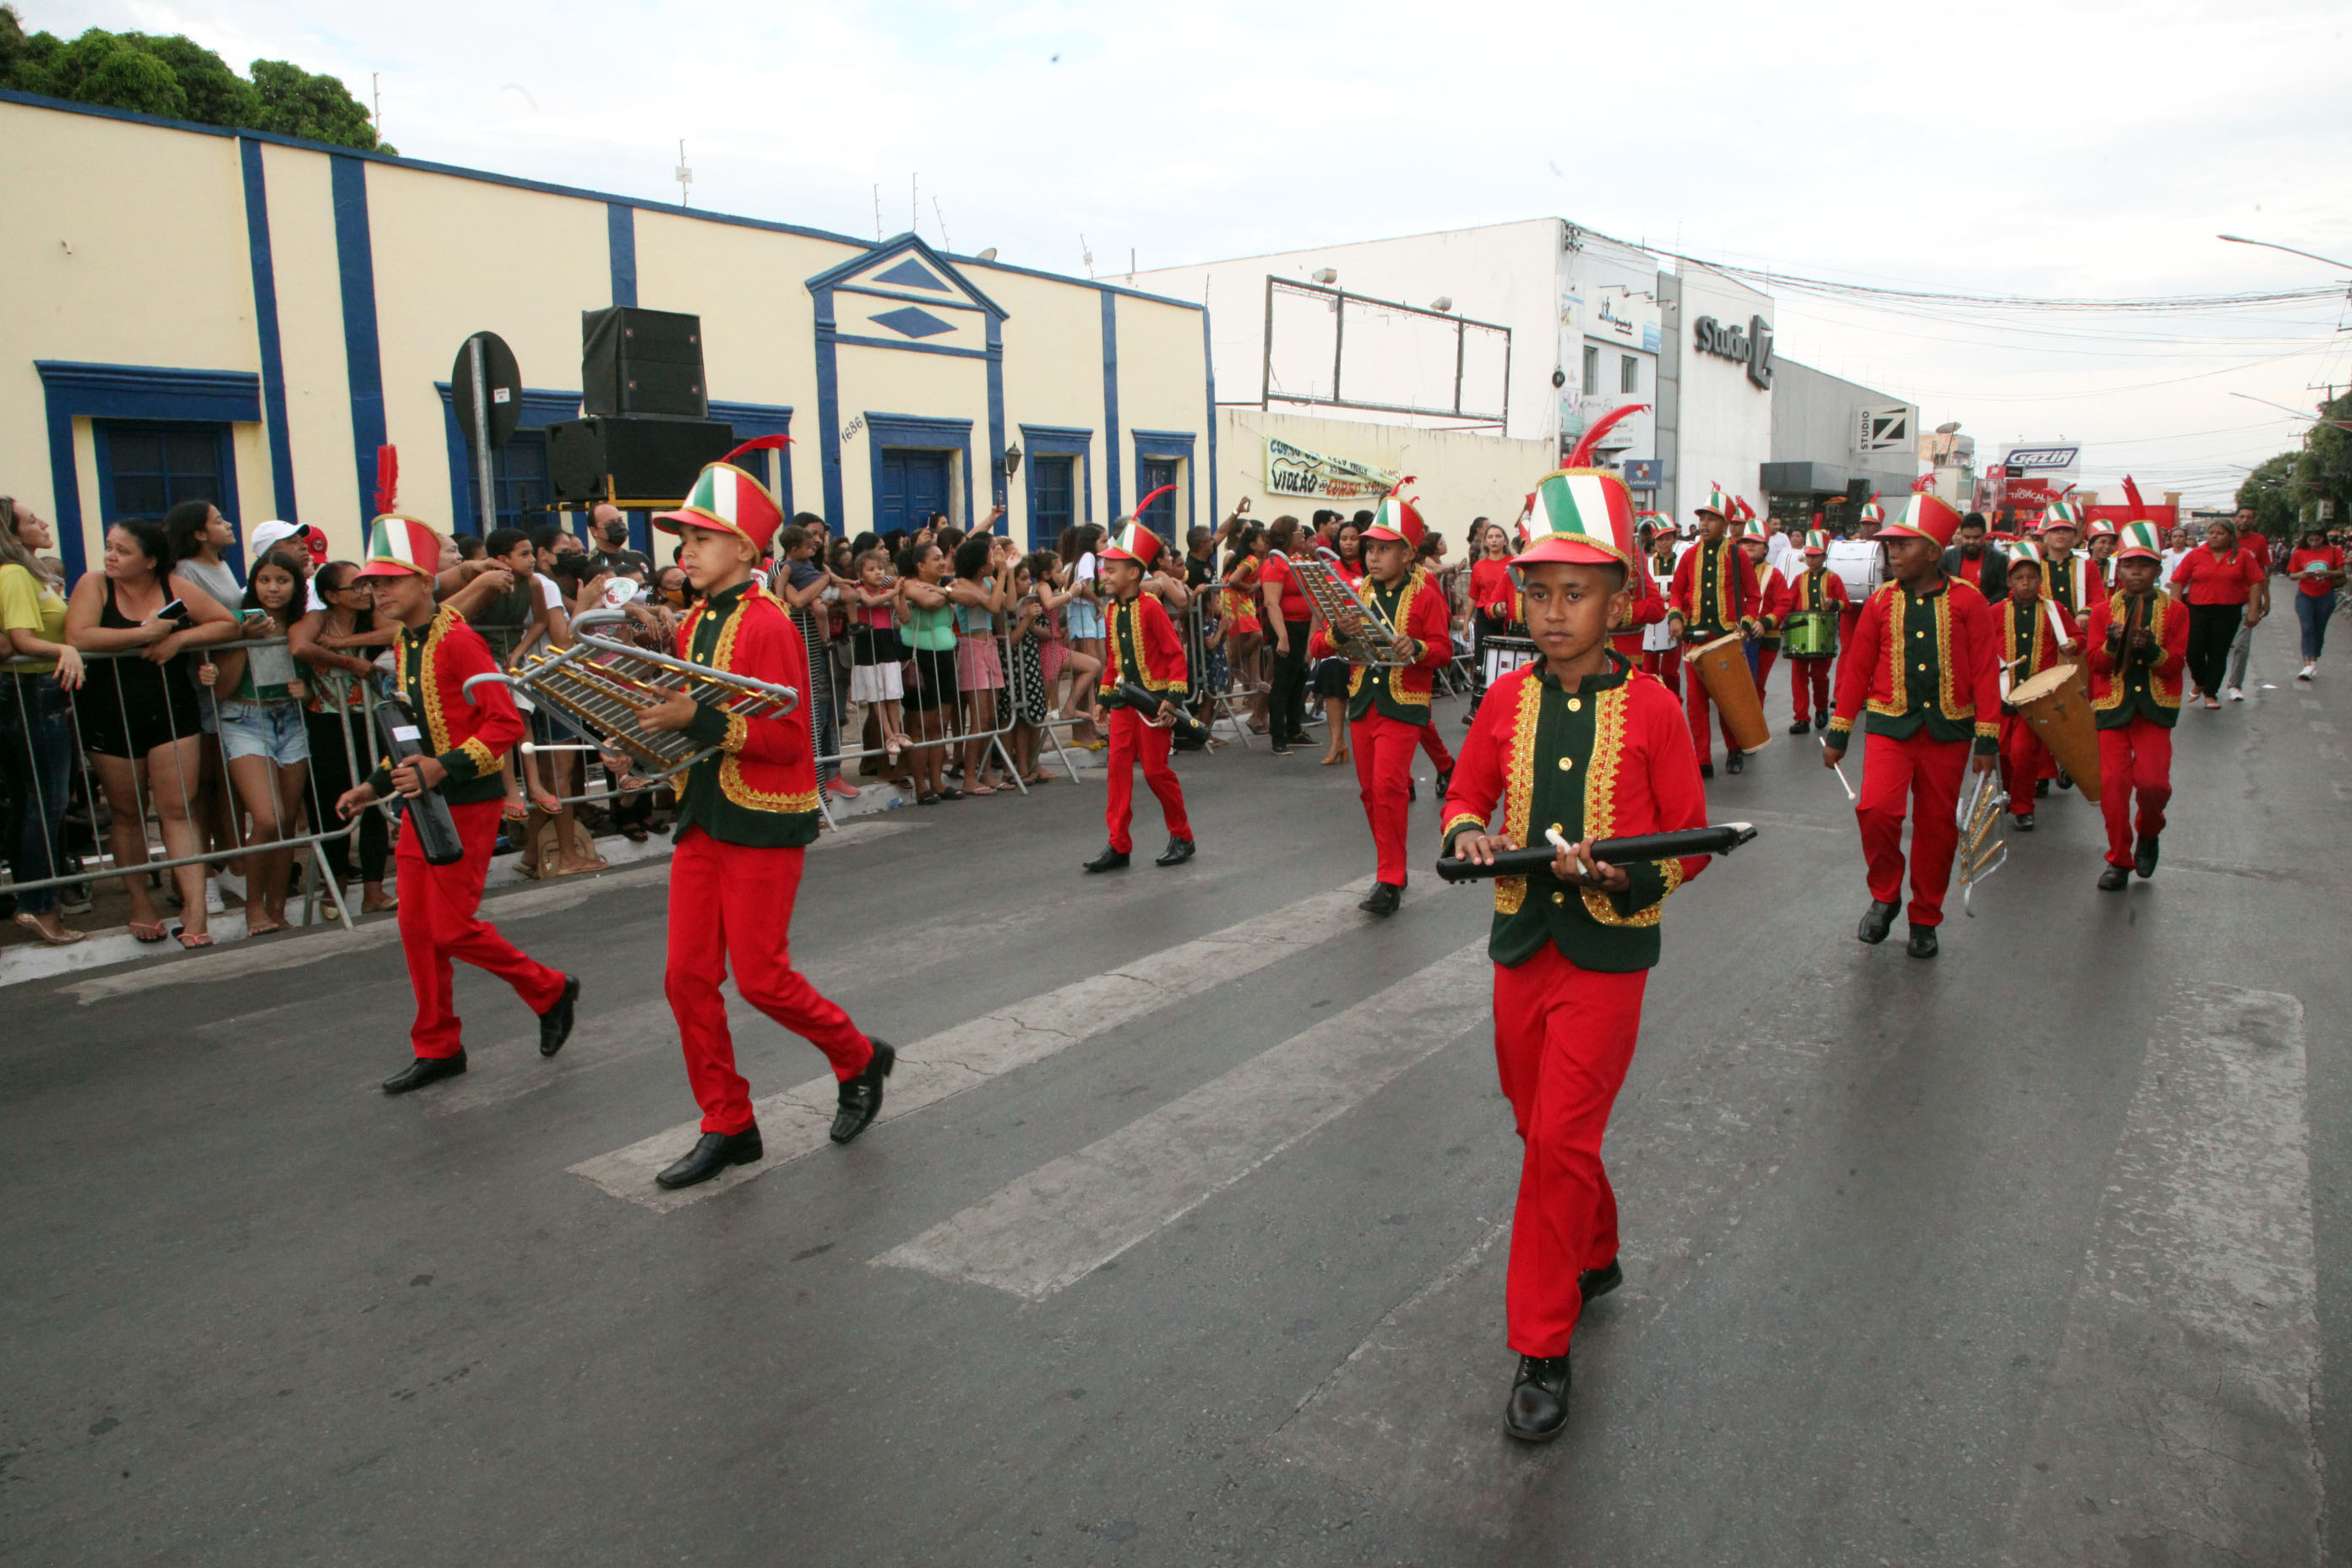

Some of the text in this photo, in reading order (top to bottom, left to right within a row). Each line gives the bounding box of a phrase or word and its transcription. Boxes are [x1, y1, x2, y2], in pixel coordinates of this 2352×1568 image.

[1694, 316, 1751, 363] Studio
[841, 416, 863, 444] 1686
[1861, 411, 1870, 450] STUDIO
[1271, 469, 1317, 493] VIOLÃO
[1326, 479, 1361, 496] CURSO
[2008, 493, 2044, 501] TROPICAL
